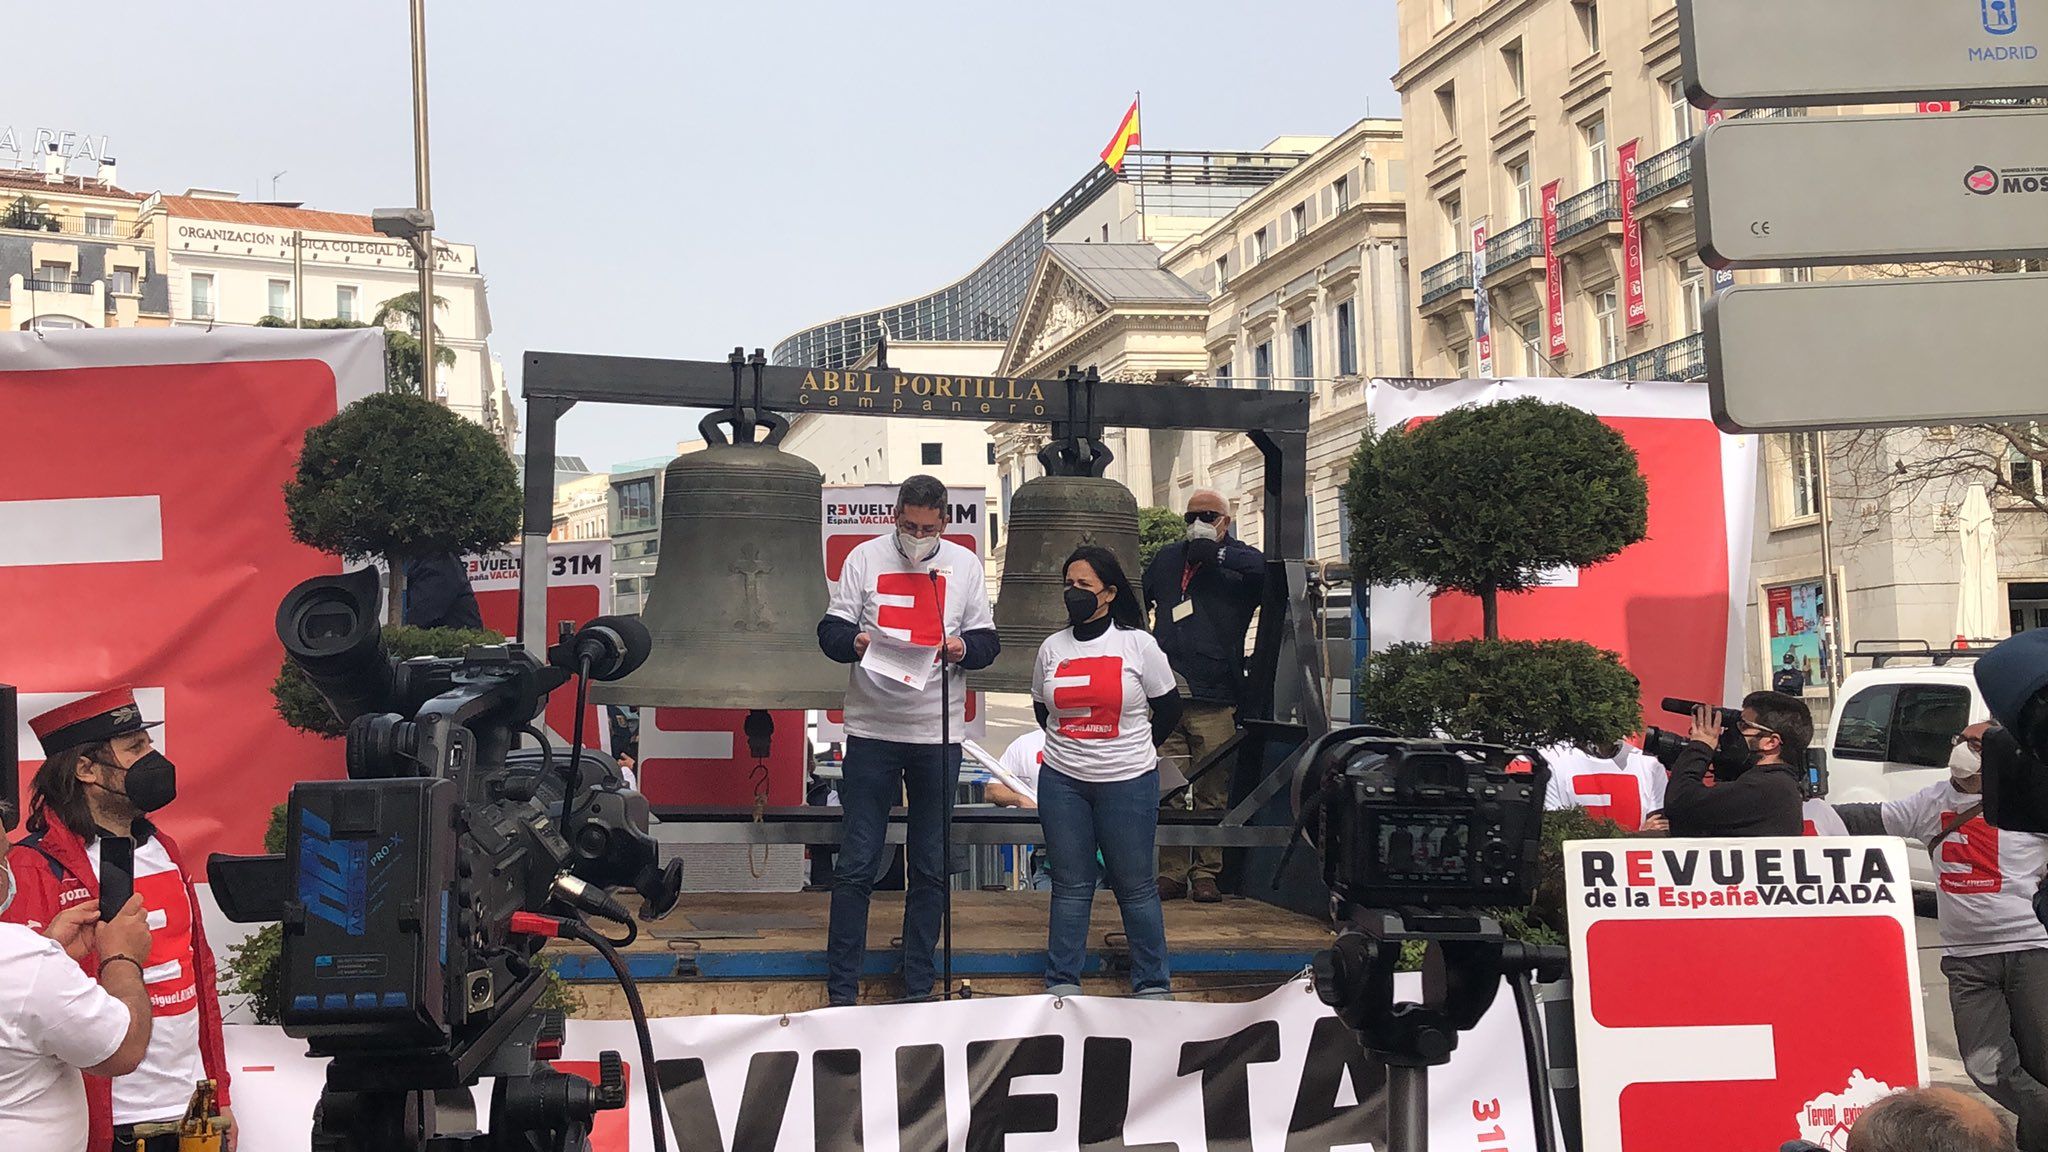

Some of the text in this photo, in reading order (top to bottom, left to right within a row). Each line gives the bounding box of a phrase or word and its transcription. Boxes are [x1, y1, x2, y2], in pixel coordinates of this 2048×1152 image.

[1968, 46, 2037, 61] MADRID
[33, 127, 116, 162] REAL
[1750, 221, 1770, 235] CE
[178, 226, 275, 245] ORGANIZACIÓN
[332, 241, 393, 257] COLEGIAL
[396, 244, 413, 258] DE
[801, 371, 1045, 401] ABEL PORTILLA
[800, 393, 1046, 416] campanero
[827, 504, 896, 516] REVUELT
[827, 516, 896, 525] España VACIAD
[490, 570, 520, 580] VACIA
[551, 555, 602, 576] 31M
[1581, 848, 1895, 887] REVUELTA
[59, 887, 91, 905] Jom
[1584, 887, 1617, 908] de
[1625, 887, 1650, 907] la
[1472, 1097, 1509, 1152] 31
[1806, 1104, 1836, 1127] Teruel
